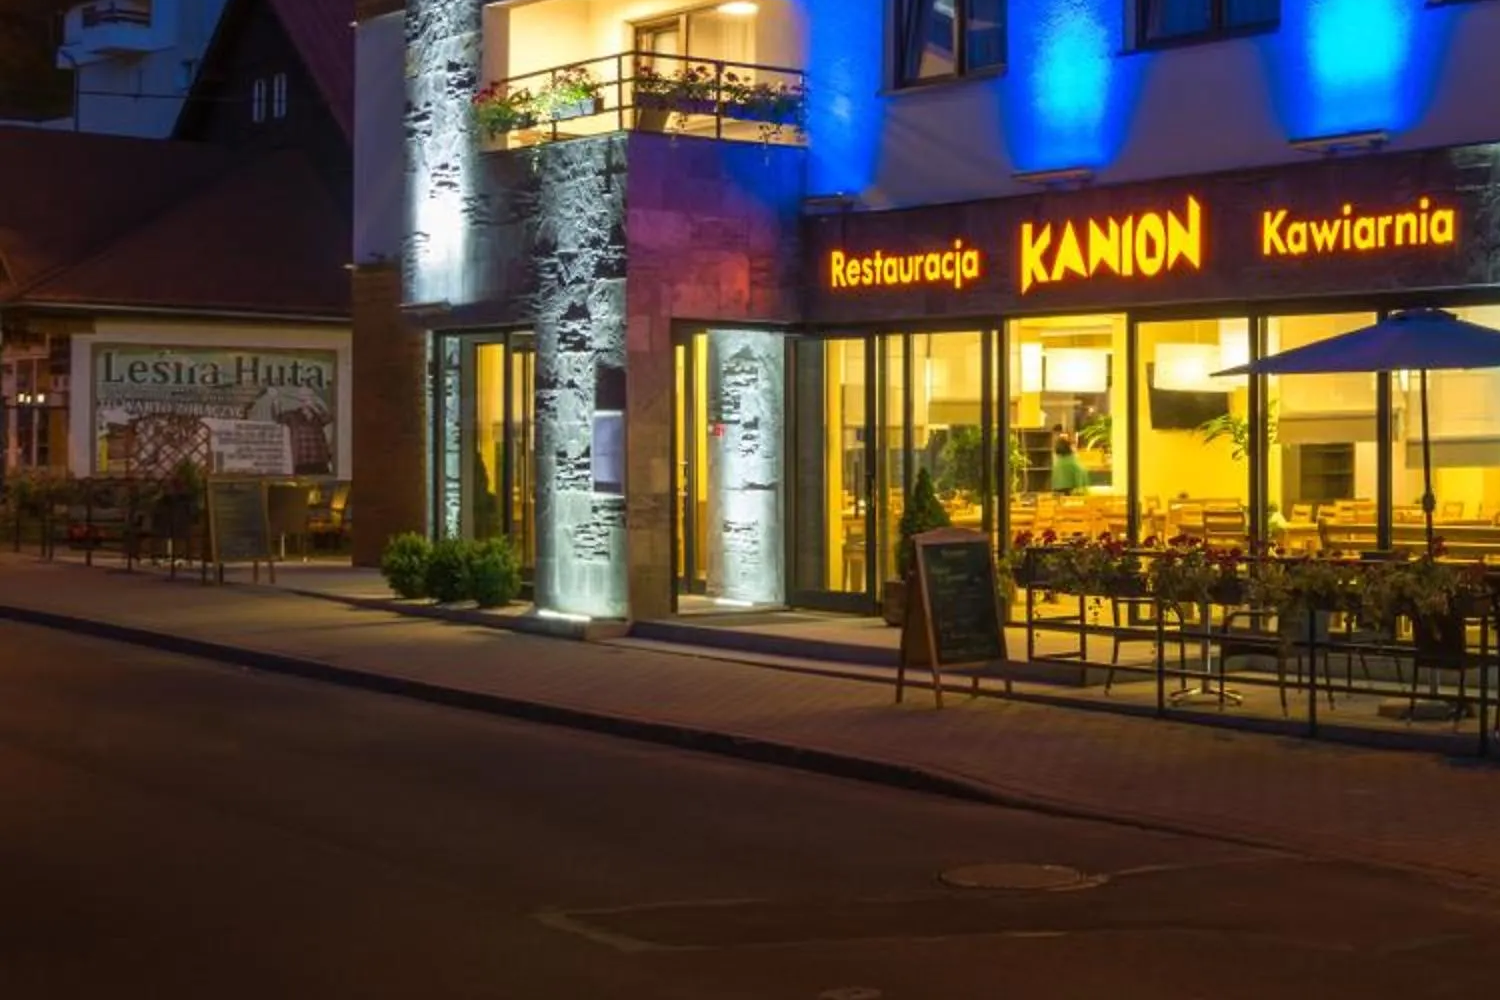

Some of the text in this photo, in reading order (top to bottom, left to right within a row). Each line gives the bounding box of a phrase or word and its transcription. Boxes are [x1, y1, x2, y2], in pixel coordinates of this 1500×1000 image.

[830, 195, 1455, 293] Restauracja KANION Kawiarnia
[236, 356, 329, 386] Huta
